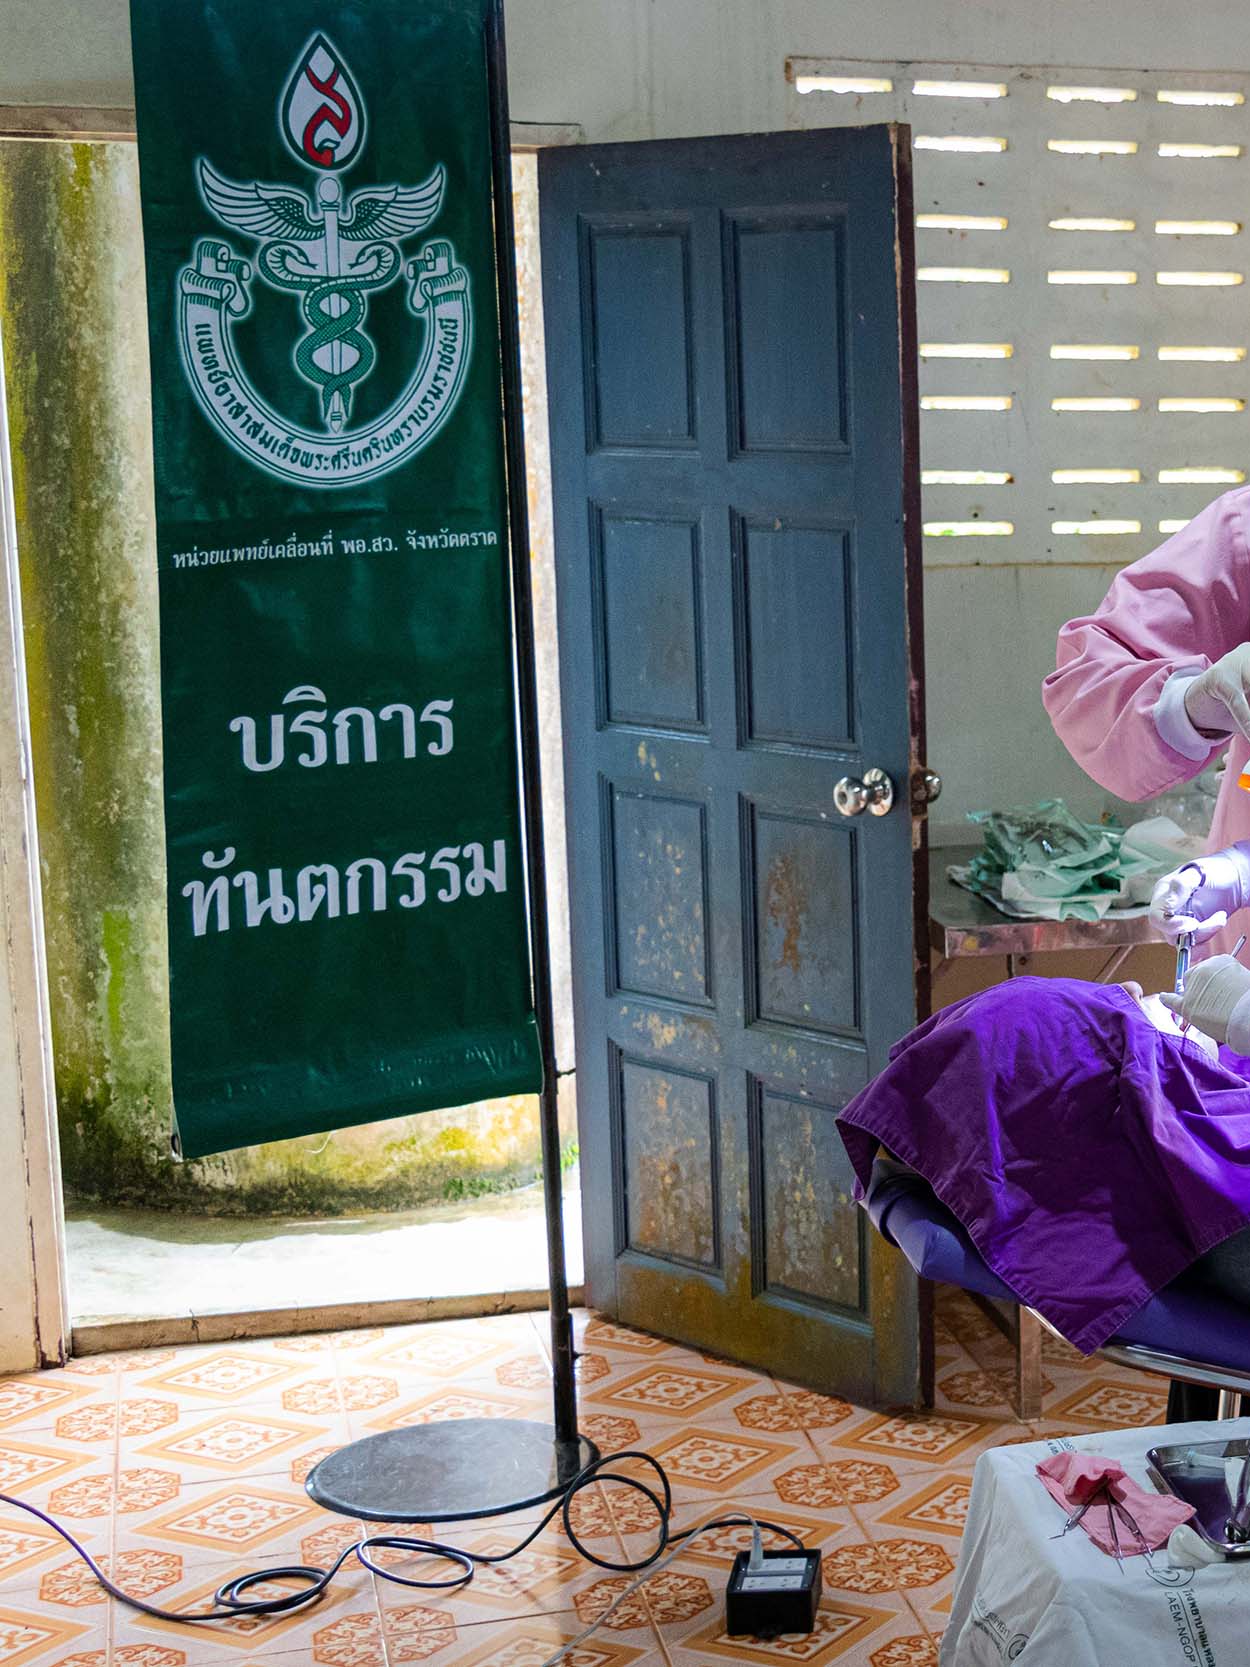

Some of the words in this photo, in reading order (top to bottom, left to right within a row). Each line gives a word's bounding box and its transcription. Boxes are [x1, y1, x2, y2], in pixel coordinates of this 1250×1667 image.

[172, 529, 334, 569] หน่วยแพทย์เคลื่อนที่
[341, 536, 398, 554] พอ.สว.
[405, 527, 498, 551] จังหวัดตราด
[229, 685, 454, 772] บริการ
[182, 839, 507, 937] ทันตกรรม
[1164, 1591, 1196, 1663] LAEM-NGOP
